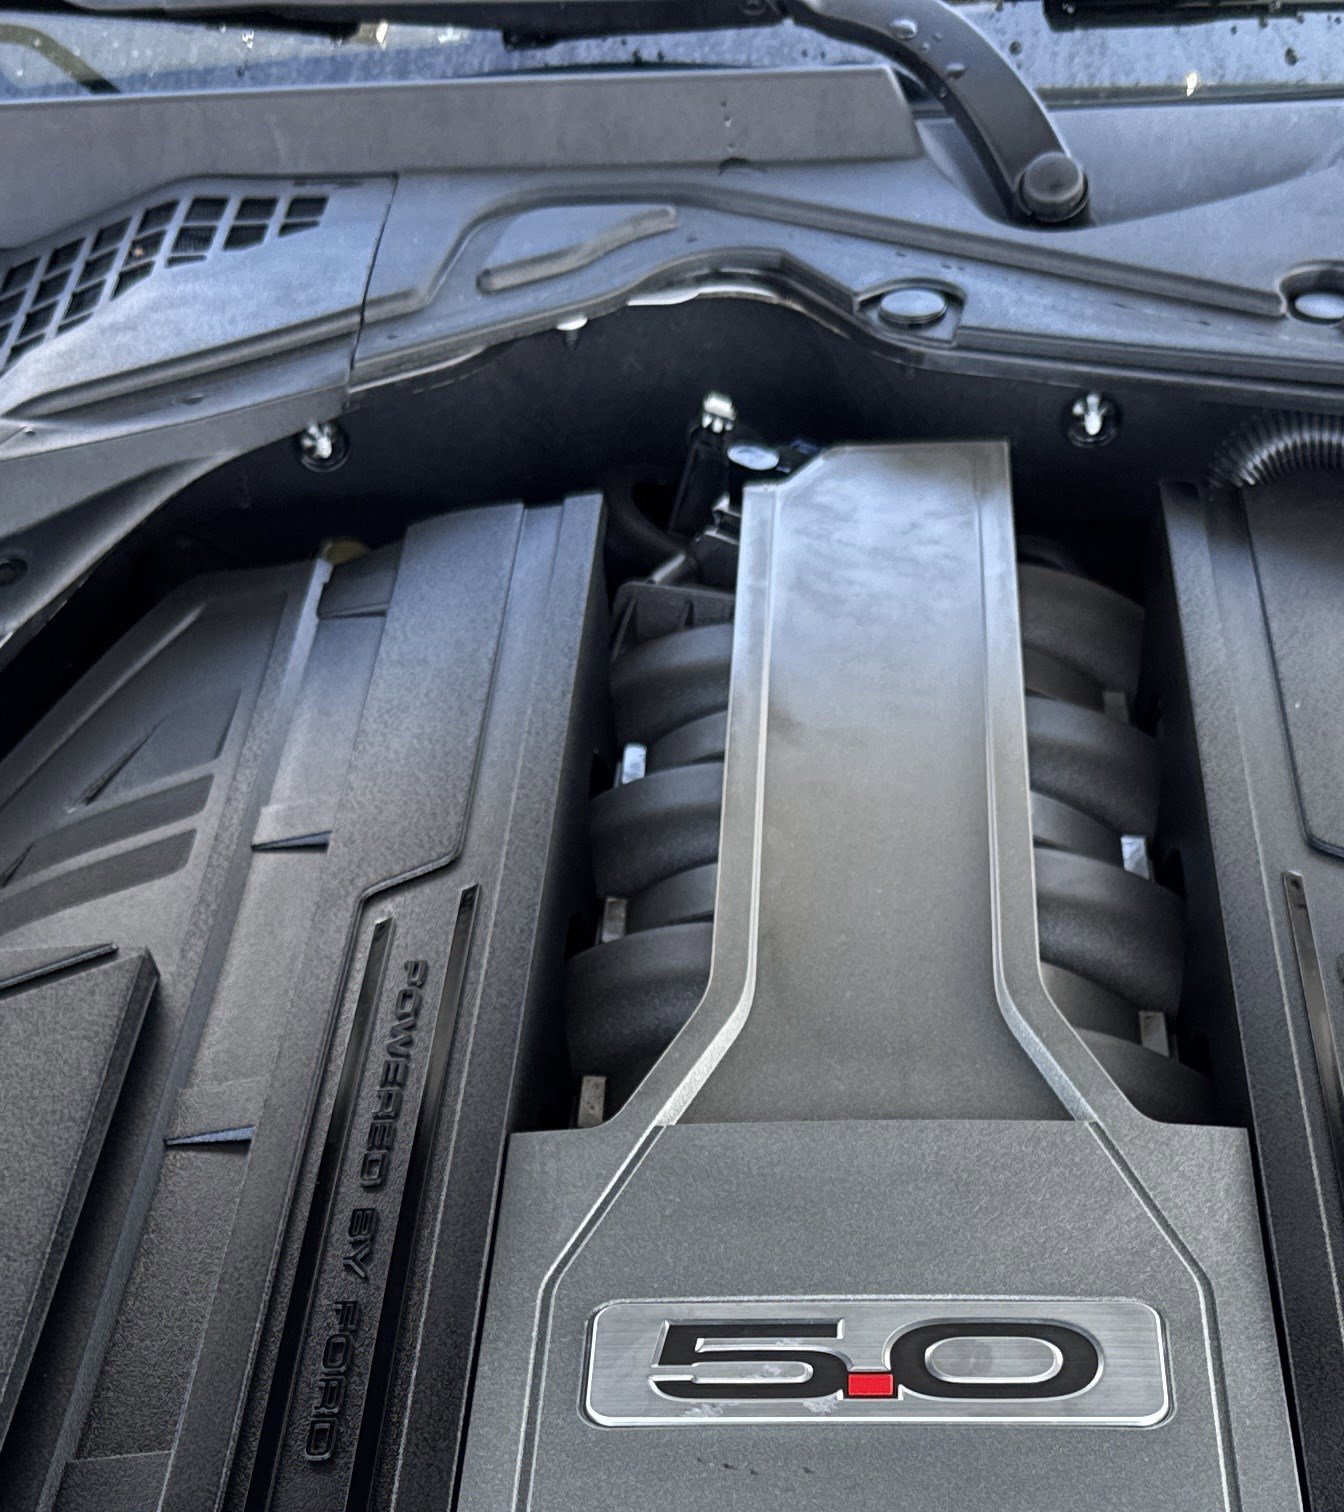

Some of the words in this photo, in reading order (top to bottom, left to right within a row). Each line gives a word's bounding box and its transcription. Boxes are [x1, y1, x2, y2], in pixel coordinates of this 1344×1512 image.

[360, 959, 430, 1189] POWERED
[342, 1206, 380, 1281] BY
[305, 1299, 359, 1464] FORD
[649, 1317, 1106, 1401] 5.0
